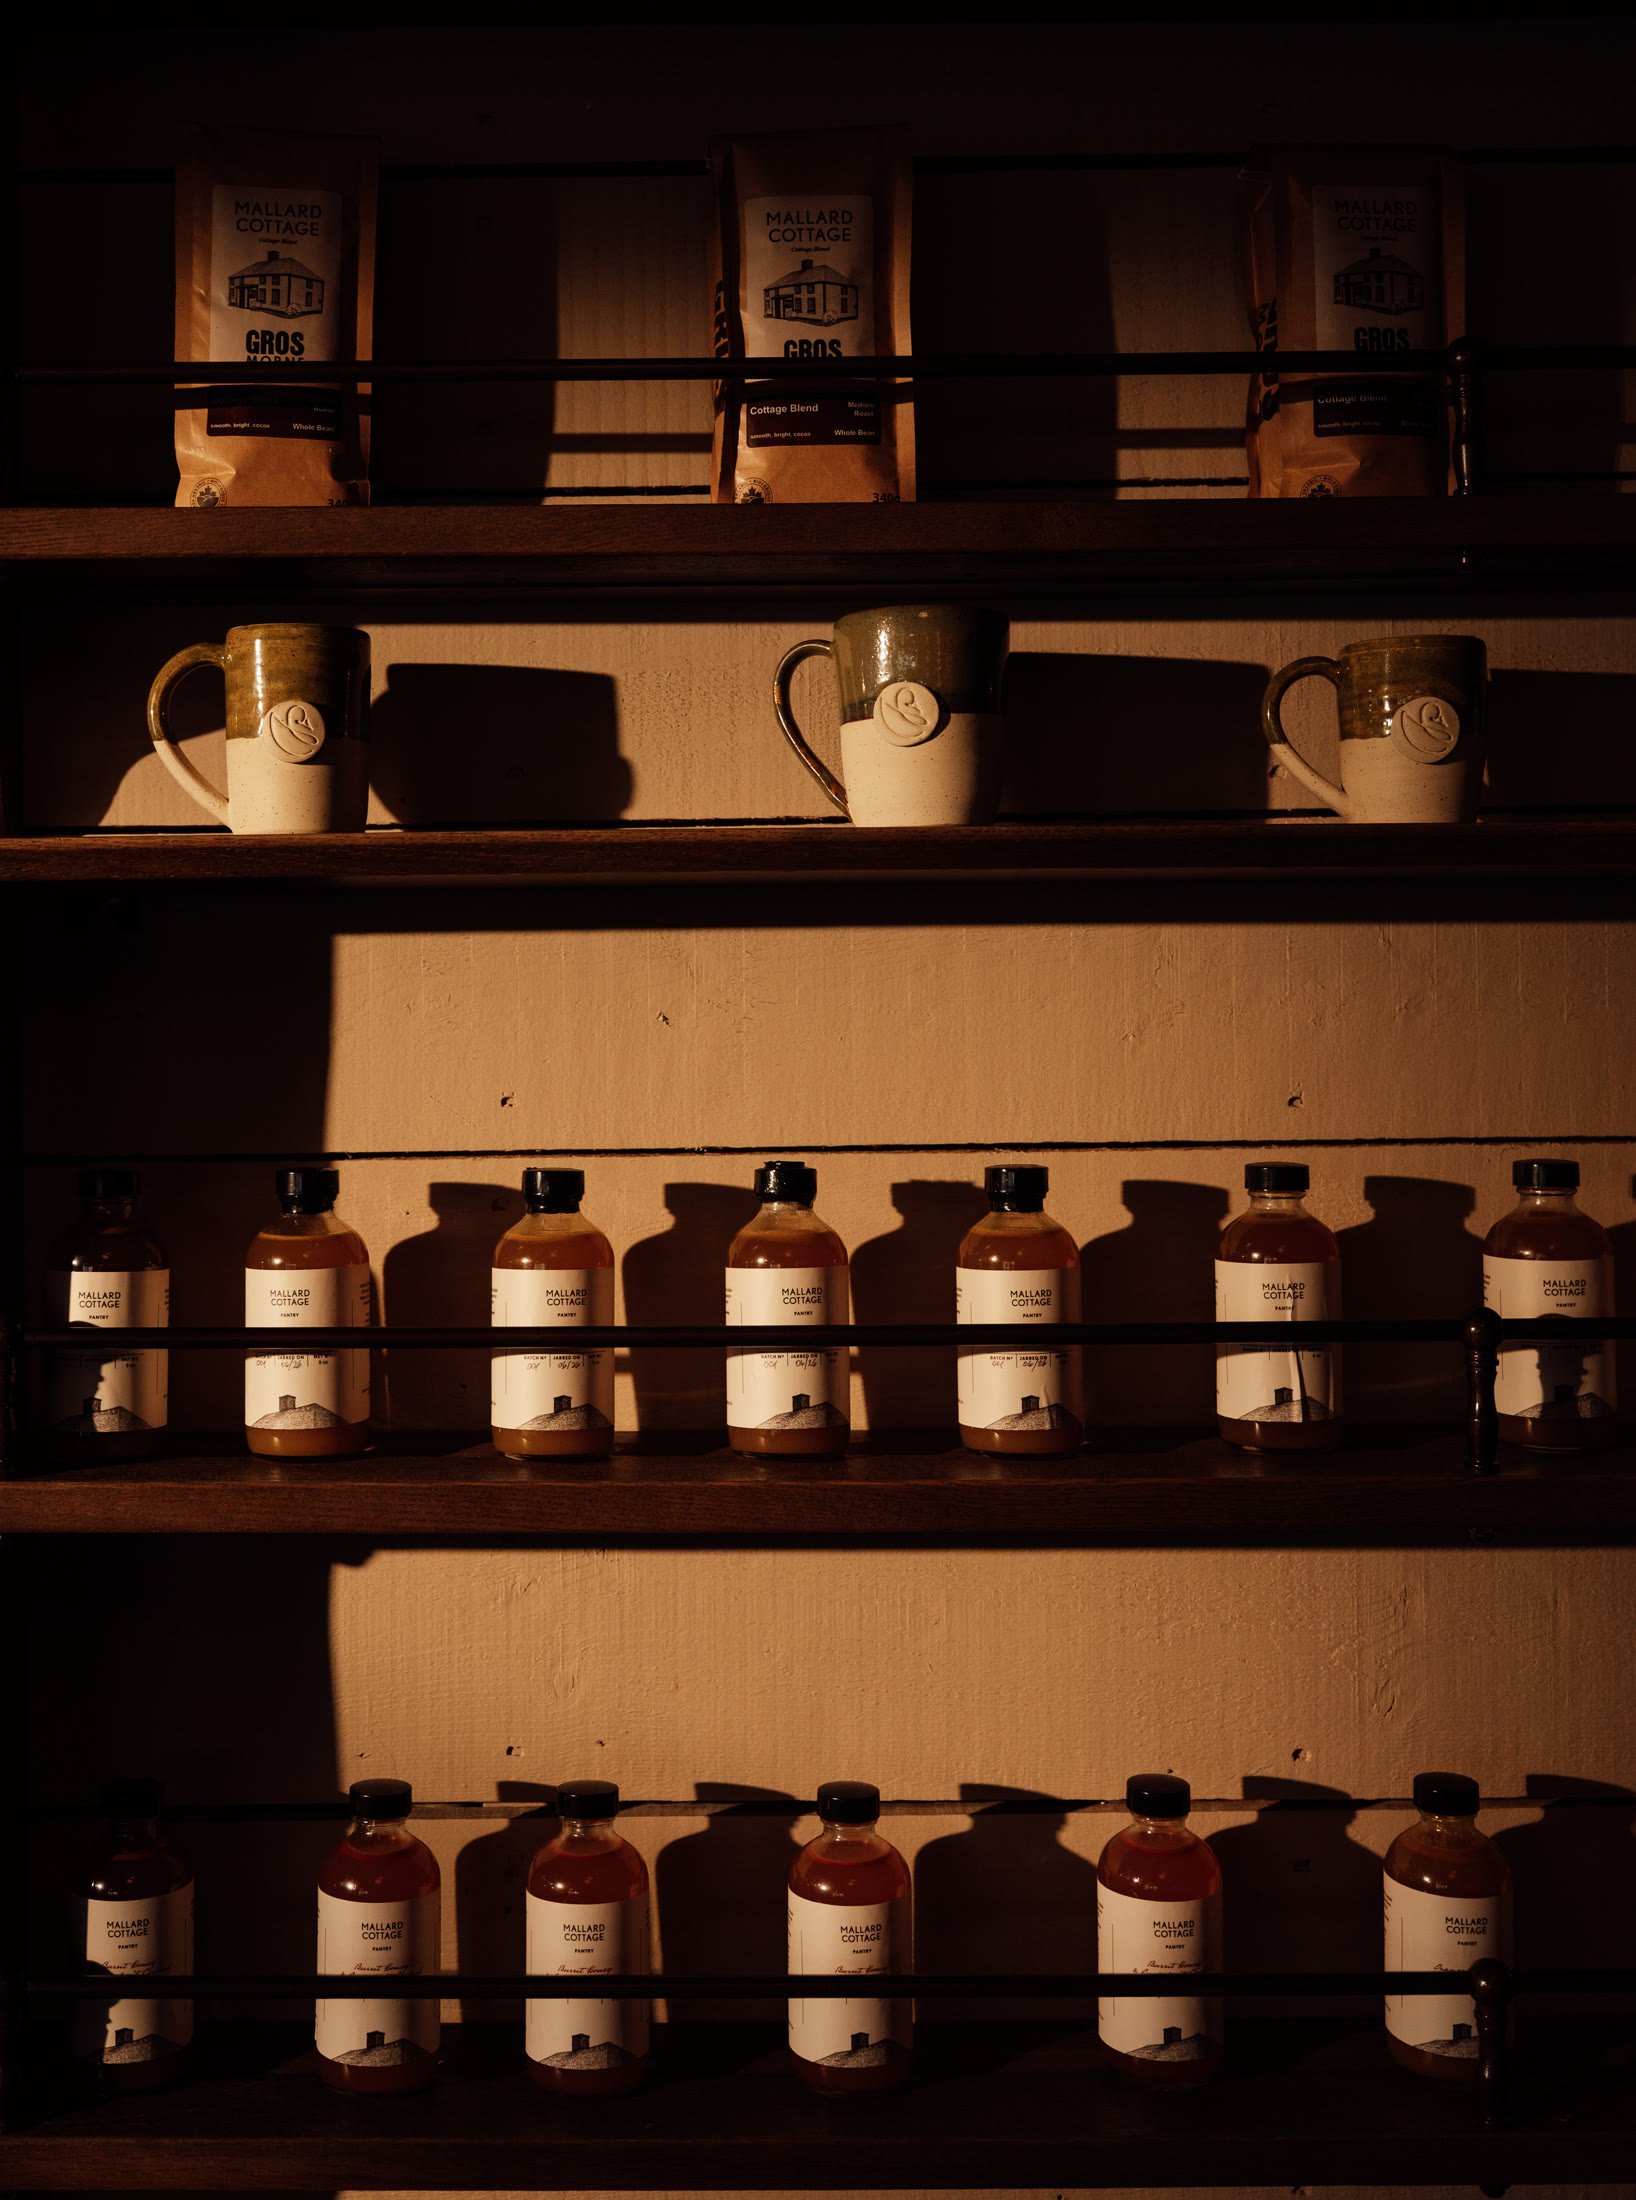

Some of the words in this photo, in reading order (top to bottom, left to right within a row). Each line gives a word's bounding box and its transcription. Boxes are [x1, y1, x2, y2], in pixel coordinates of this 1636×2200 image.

[235, 201, 322, 219] MALLARD
[1335, 199, 1417, 215] MALLARD
[766, 210, 853, 226] MALLARD
[236, 218, 320, 236] COTTAGE
[1337, 216, 1417, 233] COTTAGE
[768, 228, 852, 243] COTTAGE
[246, 329, 305, 356] GROS
[1354, 327, 1410, 351] GROS
[784, 338, 843, 358] GROS
[1317, 394, 1357, 405] Cottage
[848, 401, 875, 409] Medium
[750, 406, 788, 416] Cottage
[790, 404, 819, 413] Blend
[292, 423, 315, 431] Whole
[316, 424, 335, 432] Bean
[834, 429, 856, 437] Whole
[858, 429, 876, 437] Bean
[1262, 1282, 1306, 1291] MALLARD
[1543, 1280, 1587, 1288] MALLARD
[78, 1291, 122, 1300] MALLARD
[270, 1289, 310, 1298] MALLARD
[546, 1289, 588, 1298] MALLARD
[781, 1287, 823, 1296] MALLARD
[1010, 1289, 1052, 1298] MALLARD
[1263, 1292, 1305, 1300] COTTAGE
[1544, 1288, 1586, 1297] COTTAGE
[78, 1300, 120, 1309] COTTAGE
[270, 1298, 310, 1306] COTTAGE
[546, 1298, 586, 1306] COTTAGE
[782, 1296, 822, 1305] COTTAGE
[1011, 1298, 1052, 1307] COTTAGE
[106, 1918, 150, 1929] MALLARD
[1153, 1920, 1195, 1930] MALLARD
[1445, 1916, 1488, 1926] MALLARD
[361, 1921, 404, 1931] MALLARD
[563, 1924, 606, 1933] MALLARD
[840, 1924, 882, 1934] MALLARD
[1446, 1926, 1487, 1935] COTTAGE
[107, 1928, 149, 1938] COTTAGE
[362, 1930, 403, 1940] COTTAGE
[564, 1933, 604, 1942] COTTAGE
[841, 1932, 881, 1943] COTTAGE
[1154, 1928, 1194, 1938] COTTAGE
